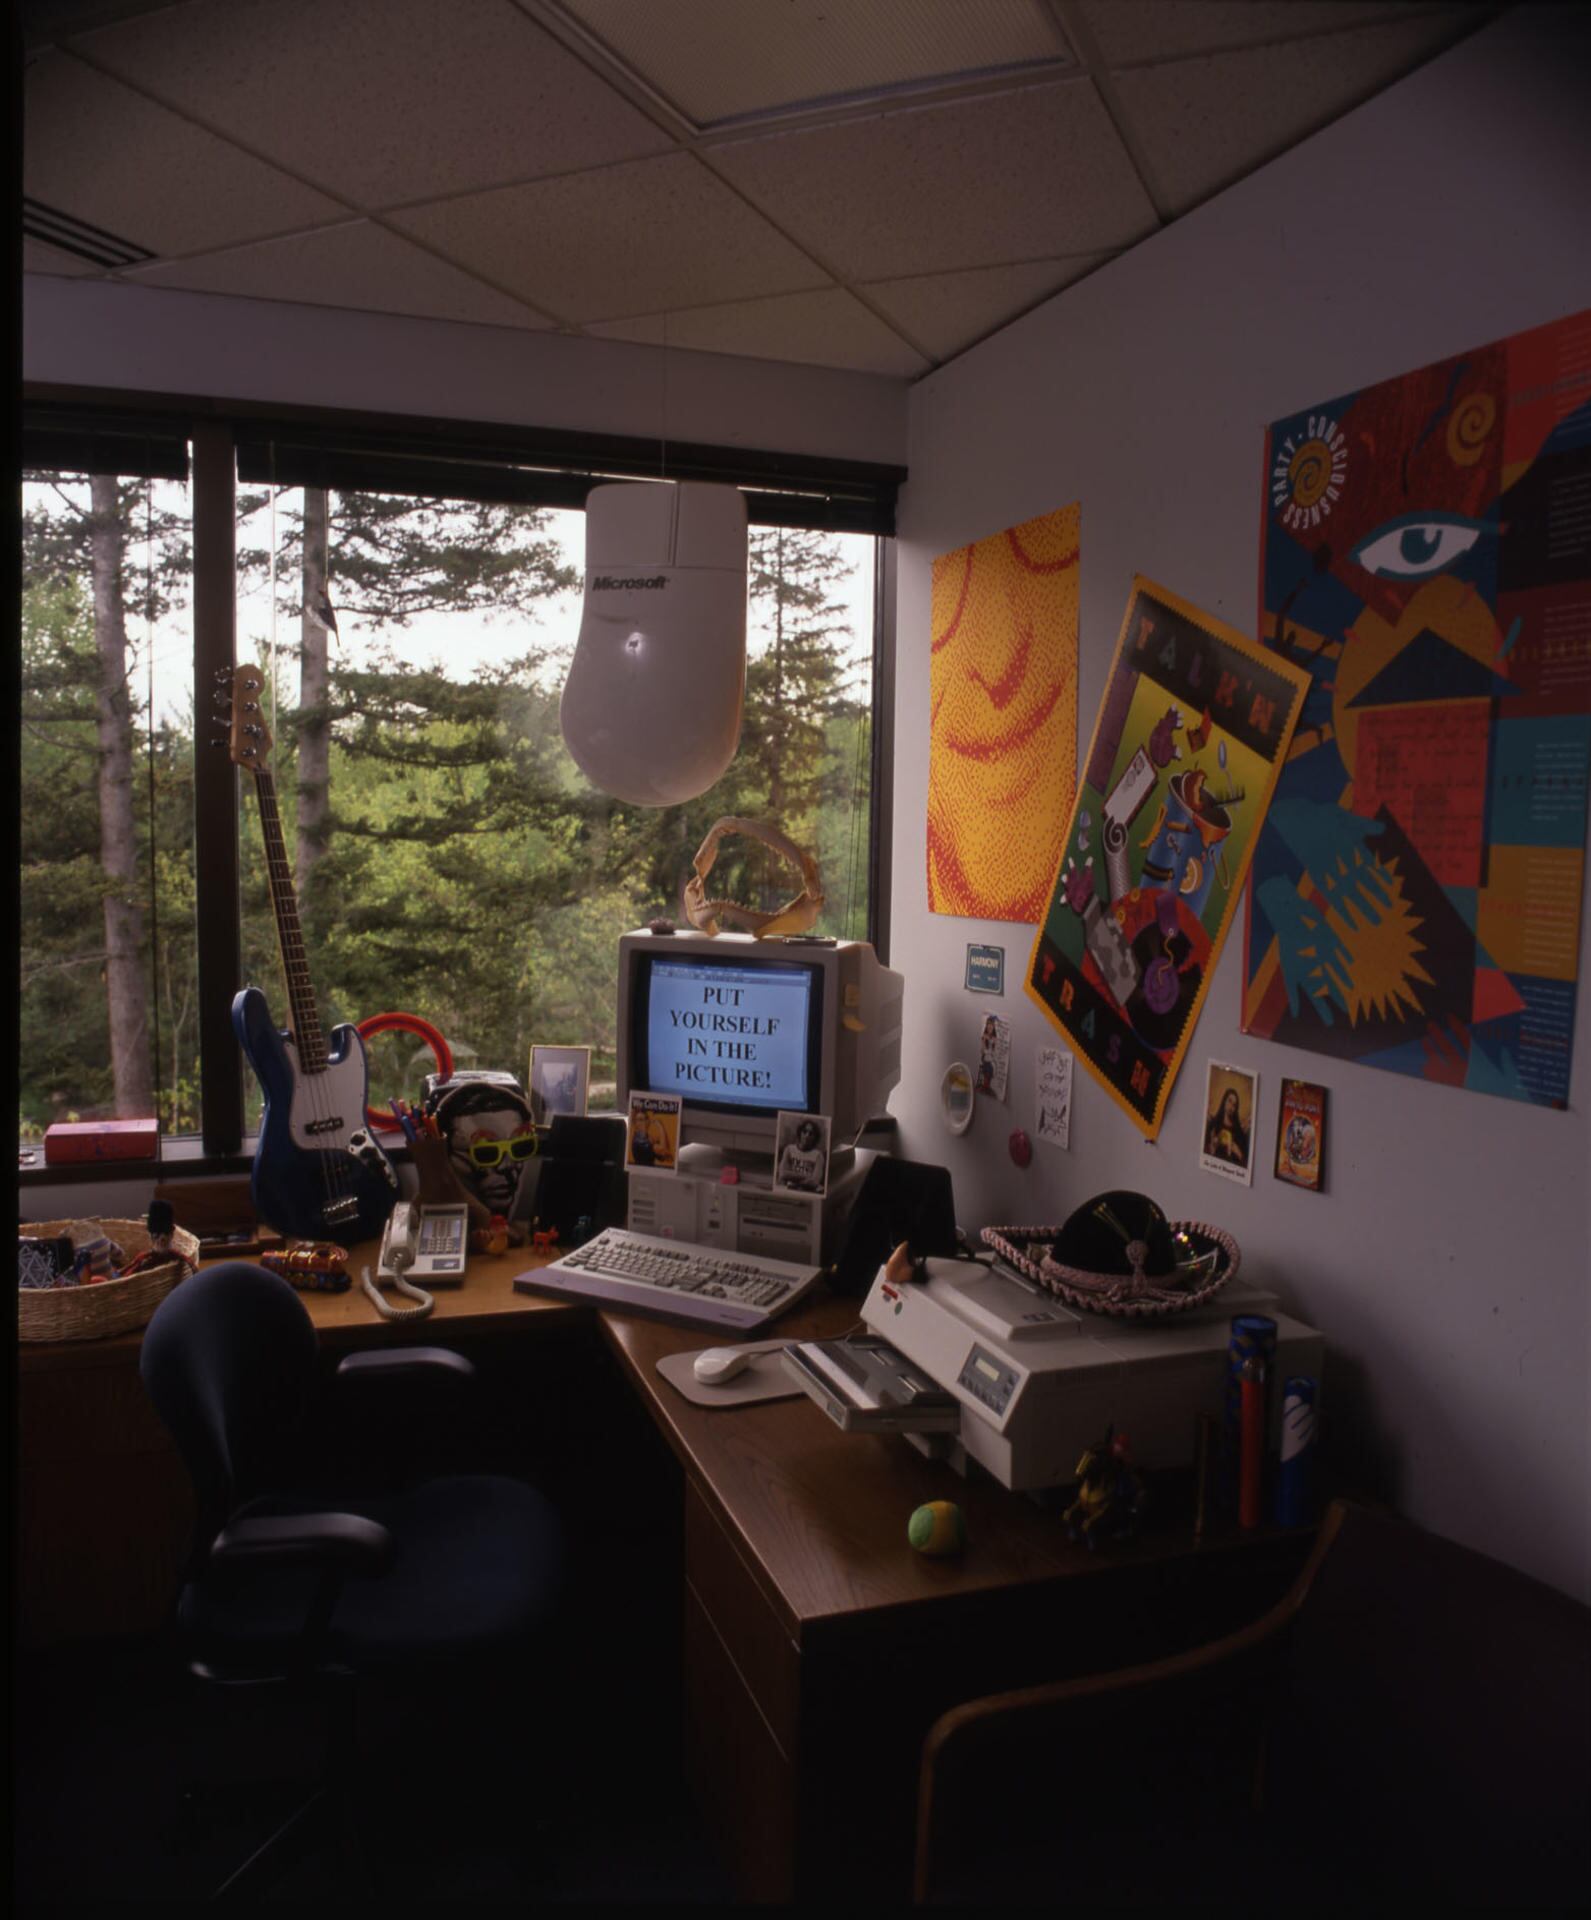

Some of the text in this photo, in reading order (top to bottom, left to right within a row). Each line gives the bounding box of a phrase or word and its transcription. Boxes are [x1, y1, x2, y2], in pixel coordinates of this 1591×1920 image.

[1272, 436, 1296, 507] PARTY
[592, 575, 666, 592] Microsoft
[703, 986, 744, 1007] PUT
[670, 1009, 780, 1036] YOURSELF
[1042, 952, 1151, 1098] TRASH
[688, 1038, 757, 1062] IN THE
[675, 1062, 771, 1089] PICTURE!
[644, 1099, 657, 1110] Can
[658, 1100, 668, 1111] Do
